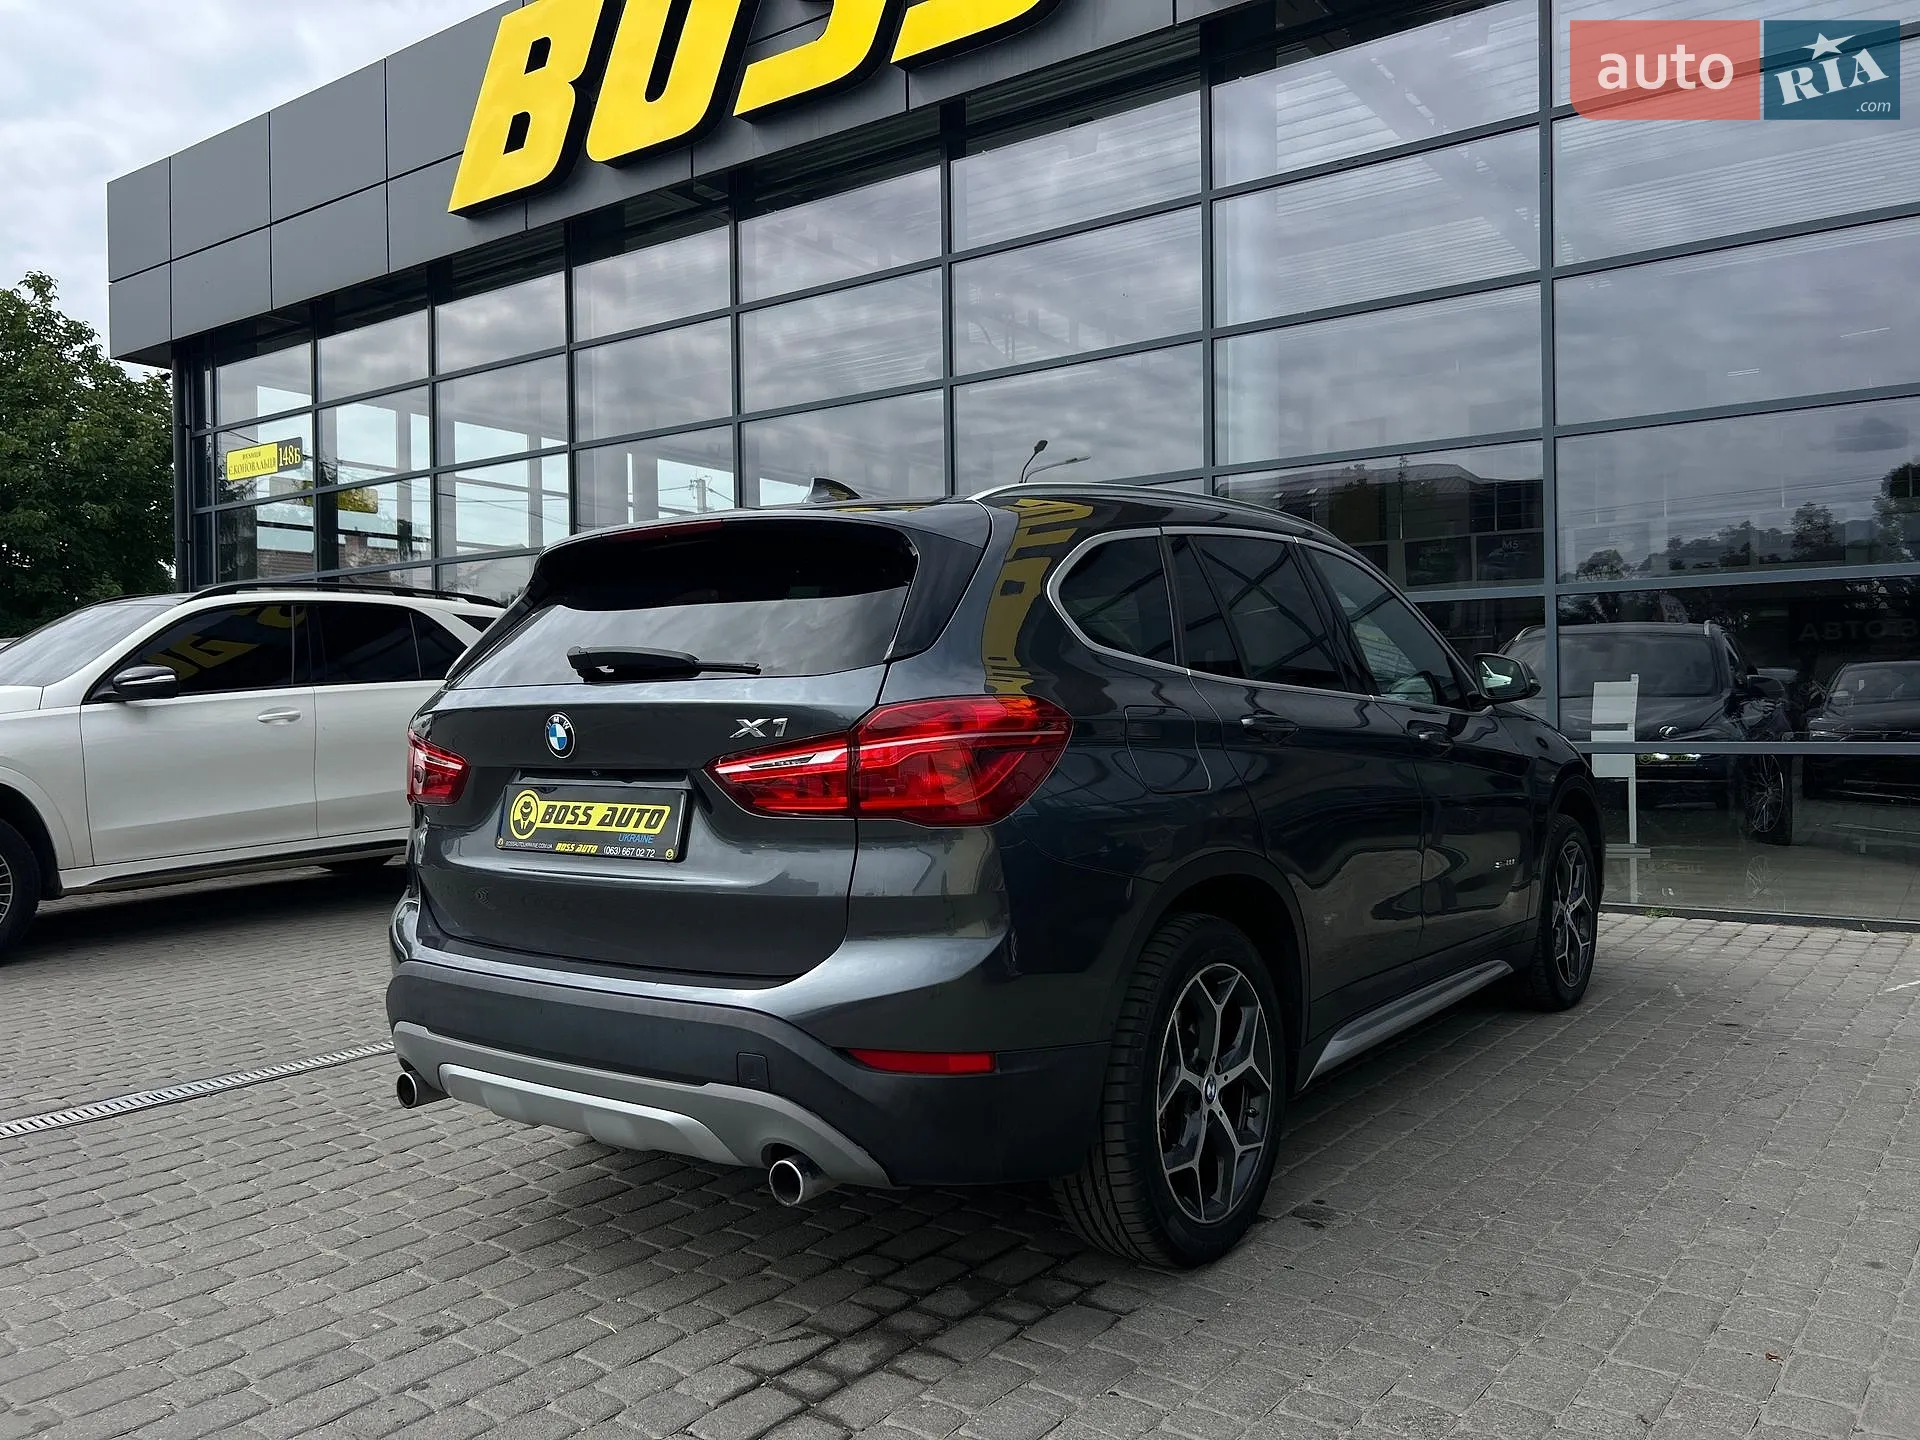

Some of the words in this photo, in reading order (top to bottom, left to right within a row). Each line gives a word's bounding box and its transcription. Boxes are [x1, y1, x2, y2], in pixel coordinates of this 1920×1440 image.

[279, 445, 301, 467] 148Б
[729, 717, 790, 739] X1
[540, 804, 594, 826] BOSS
[596, 806, 666, 830] AUTO
[618, 833, 655, 844] UKRAINE
[555, 842, 575, 852] BOSS
[575, 844, 598, 854] AUTO
[603, 845, 621, 855] (063)
[621, 847, 635, 856] 667
[636, 848, 645, 857] 02
[646, 849, 656, 858] 72
